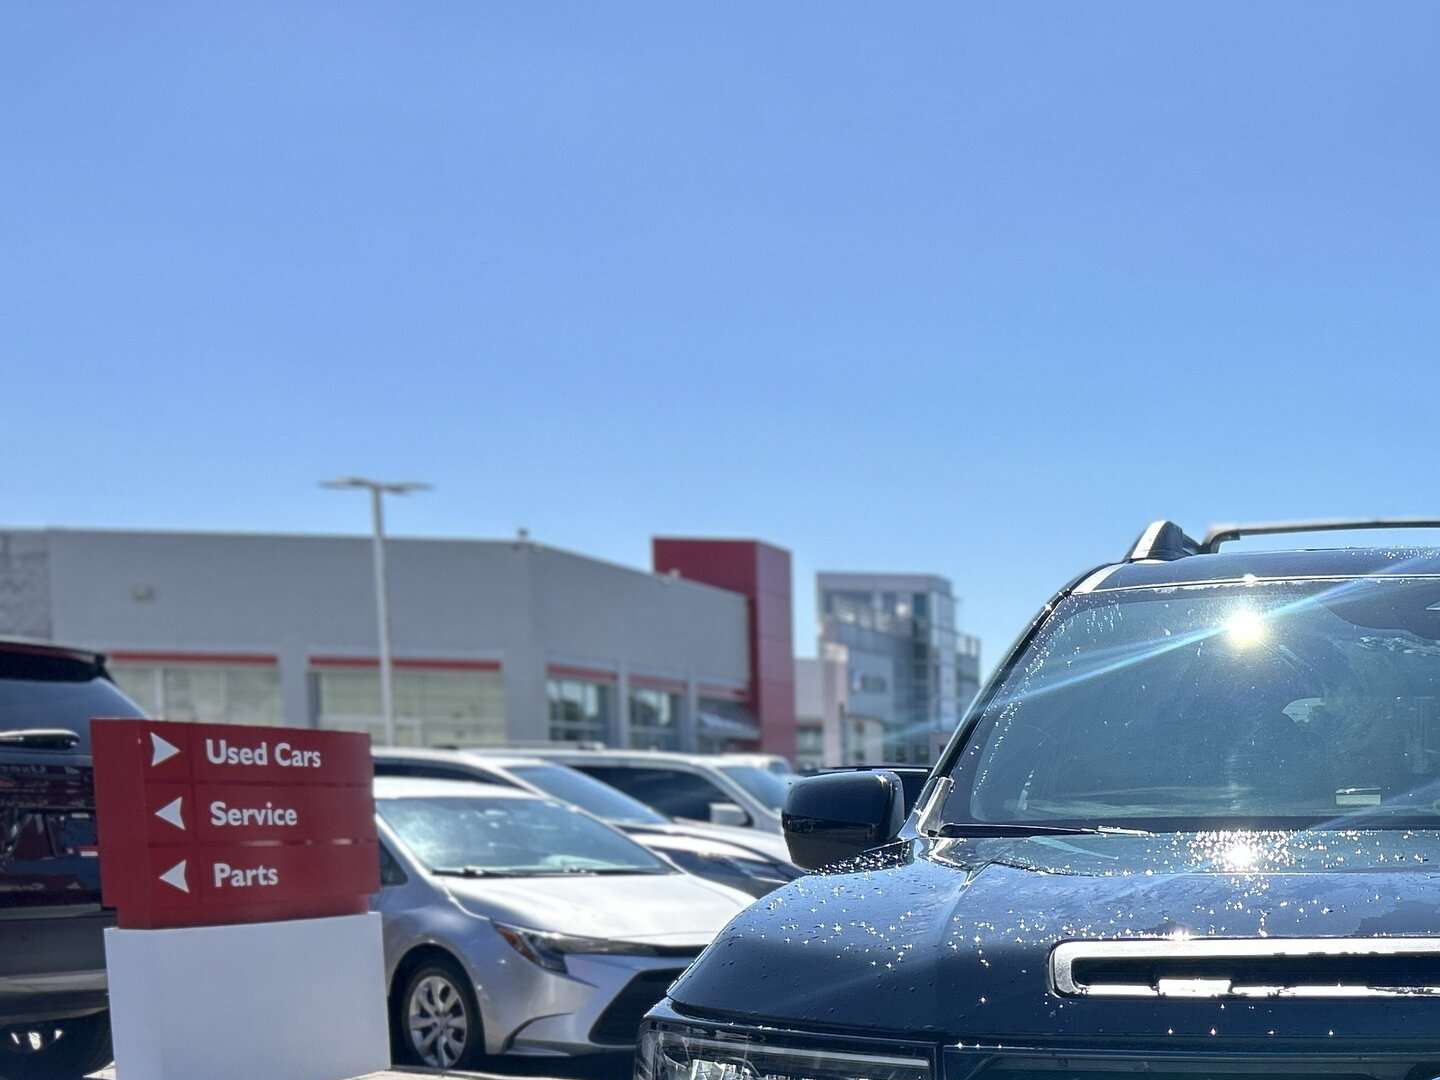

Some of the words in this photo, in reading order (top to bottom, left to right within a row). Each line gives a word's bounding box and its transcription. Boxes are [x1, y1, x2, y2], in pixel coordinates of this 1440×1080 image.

[206, 739, 268, 765] Used
[274, 743, 321, 768] Cars
[210, 801, 298, 826] Service
[213, 863, 279, 887] Parts
